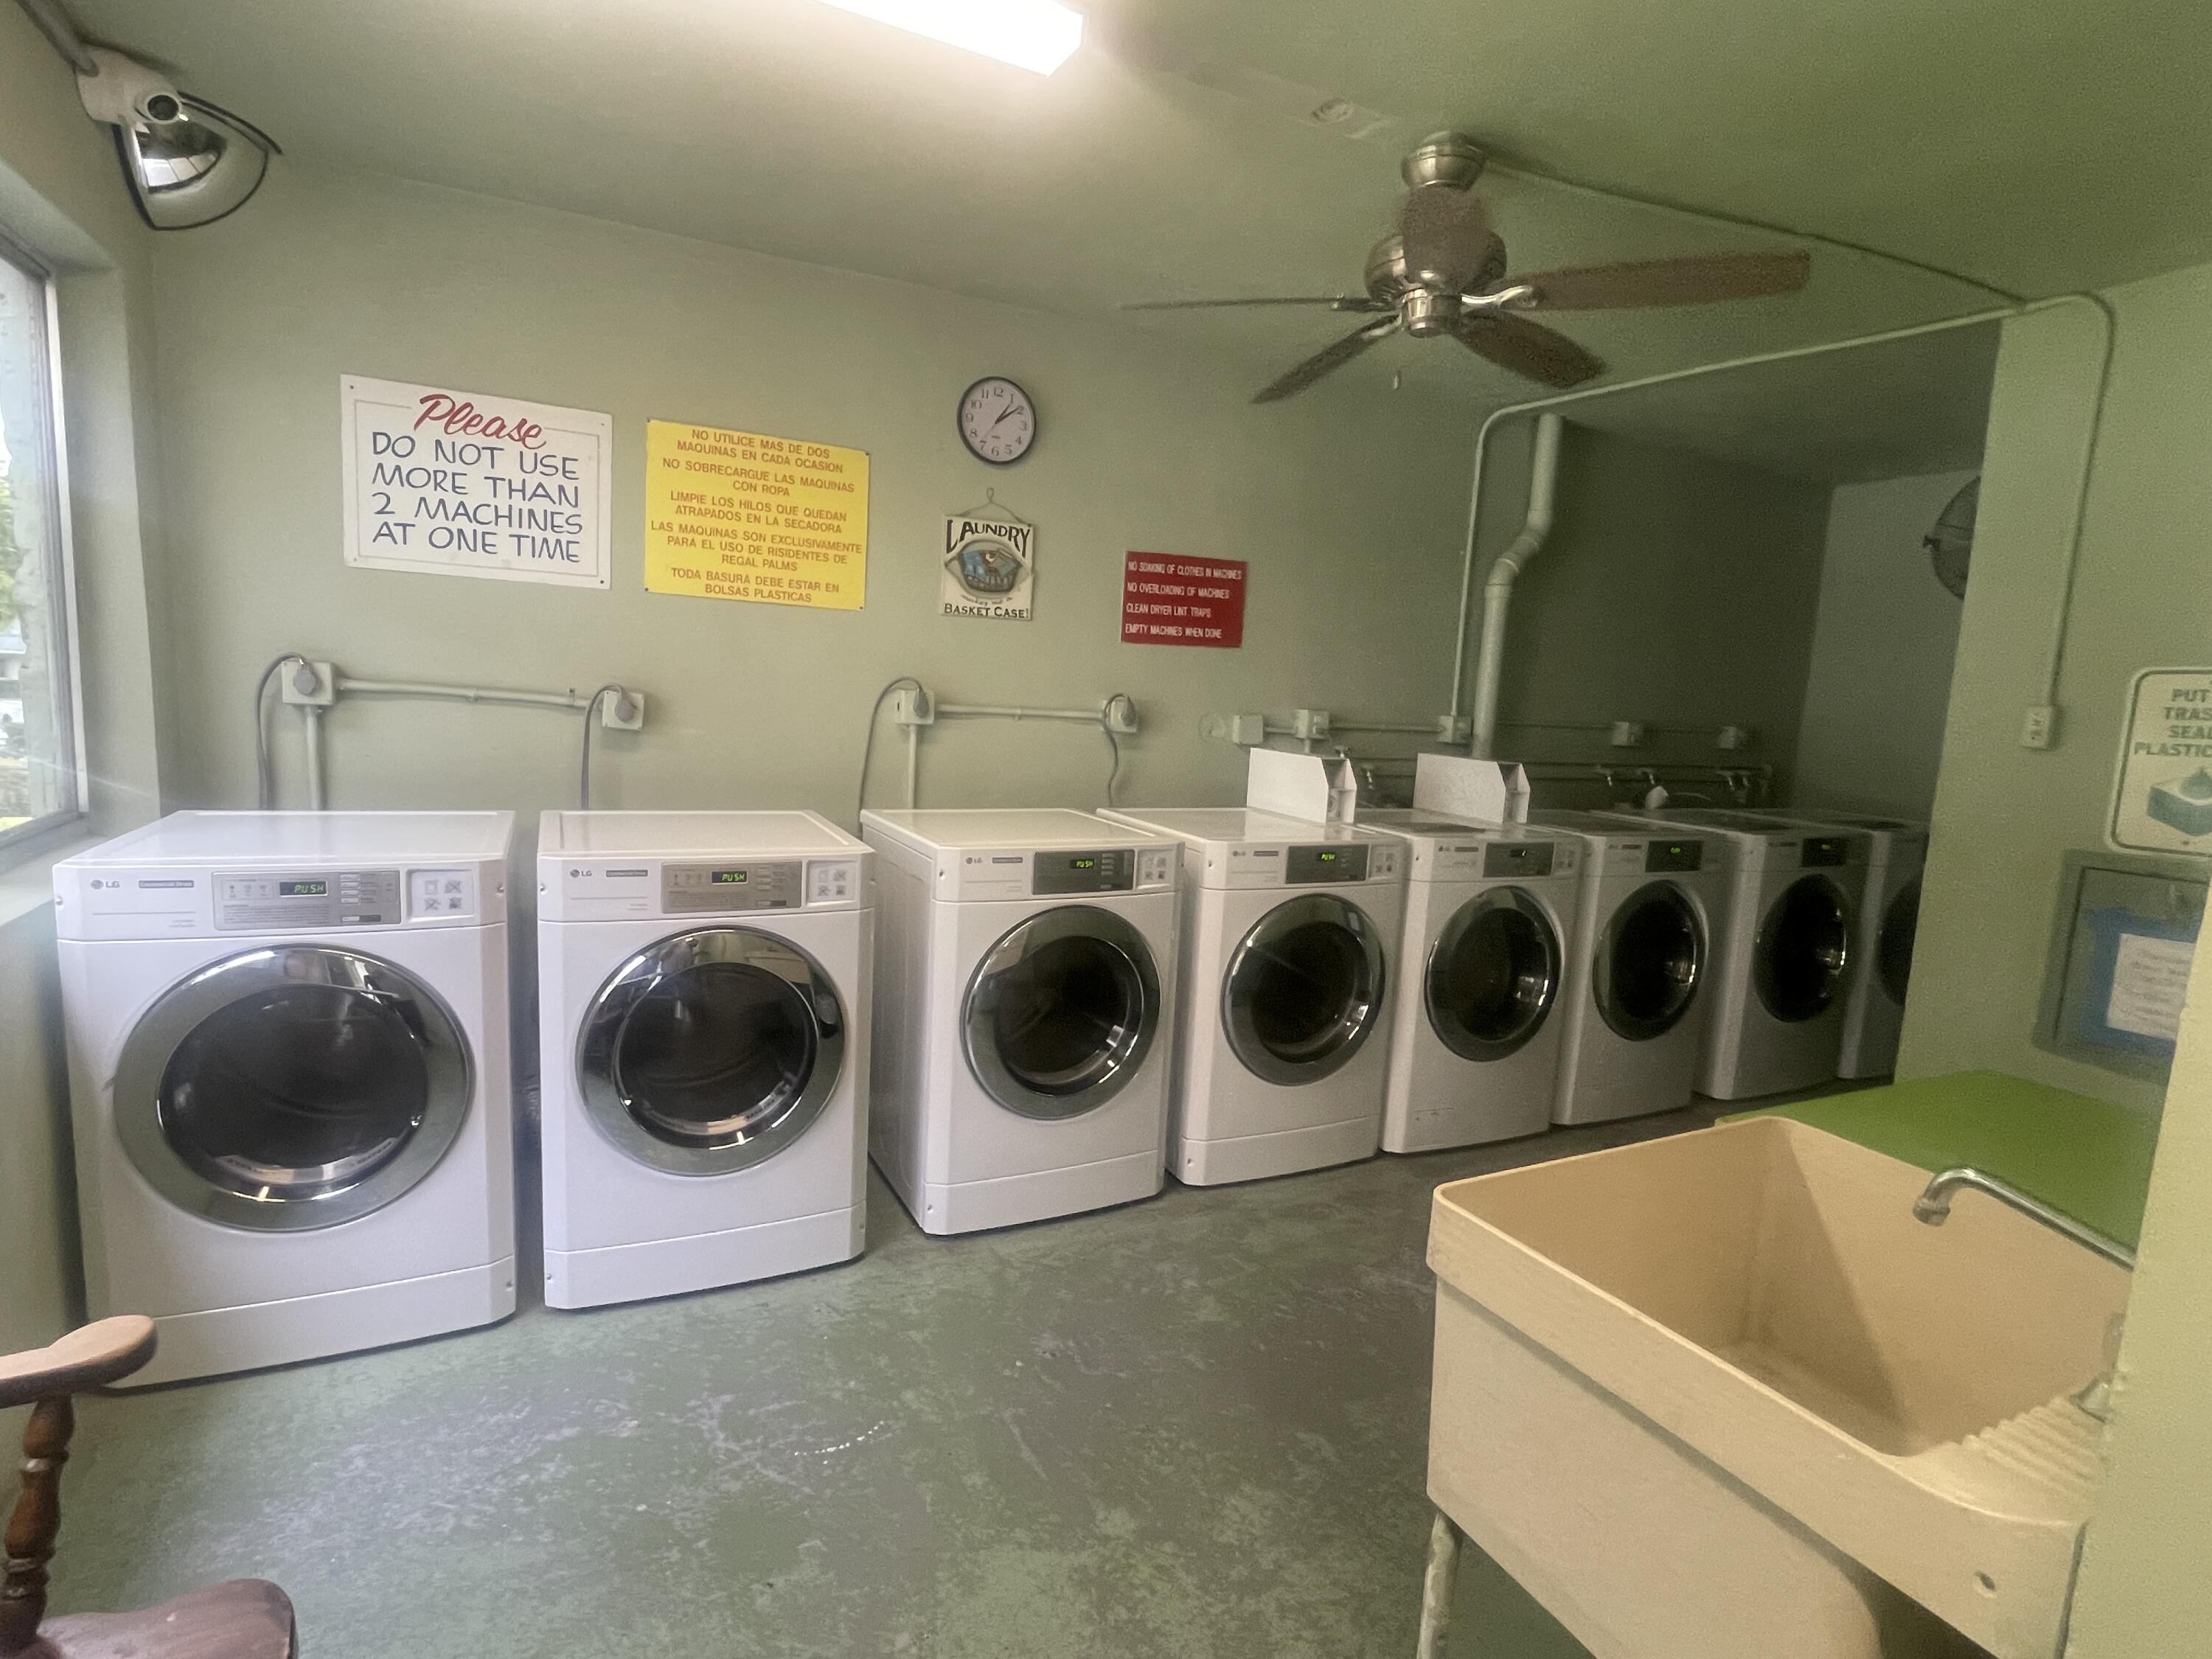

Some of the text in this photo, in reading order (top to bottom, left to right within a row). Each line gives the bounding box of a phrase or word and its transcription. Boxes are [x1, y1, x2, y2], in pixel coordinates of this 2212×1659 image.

[981, 388, 989, 399] 11
[993, 386, 1004, 397] 12
[970, 400, 982, 409] 10
[1017, 406, 1024, 415] 2
[414, 394, 547, 450] Please
[965, 412, 973, 422] 9
[1019, 420, 1027, 431] 3
[970, 428, 978, 437] 8
[1015, 436, 1021, 445] 4
[692, 428, 830, 459] NO UTILICE MAS DE DOS
[979, 439, 987, 451] 7
[991, 446, 999, 456] 6
[1004, 444, 1012, 455] 5
[372, 431, 580, 480] DO NOT USE
[677, 440, 844, 473] MAQUINAS EN CADA OCASION
[663, 457, 855, 493] NO SOBRECARGUE LAS MAQUINAS
[372, 462, 579, 508] MORE THAN
[733, 480, 790, 497] CON ROPA
[372, 492, 582, 535] 2 MACHINES
[670, 490, 846, 522] LIMPIE LOS HILOS QUE QUEDAN
[675, 505, 842, 534] ATRAPADOS EN LA SECADORA
[372, 521, 580, 563] AT ONE TIME
[651, 520, 862, 554] LAS MAQUINAS SON EXCLUSIVAMENTE
[946, 519, 1031, 558] LAUNDRY
[667, 535, 847, 564] PARA EL USO DE RISIDENTES DE
[722, 554, 797, 571] REGAL PALMS
[1128, 561, 1242, 580] NO SOAKING OF CLOTHES IN MACHINES
[671, 567, 839, 594] TODA BASURA DEBE ESTAR EN
[705, 583, 812, 602] BOLSAS PLASTICAS
[1127, 582, 1231, 599] NO OVERLOADING OF MACHINES
[944, 602, 991, 617] BASKET
[994, 606, 1029, 619] CASE!
[1126, 602, 1211, 618] CLEAN DRYER LINT TRAPS
[1125, 623, 1222, 639] EMPTY MACHINES WHEN DONE
[2171, 688, 2211, 703] PUT
[2163, 707, 2212, 721] TRAS
[722, 873, 745, 881] PUSH
[294, 883, 324, 894] PUSH
